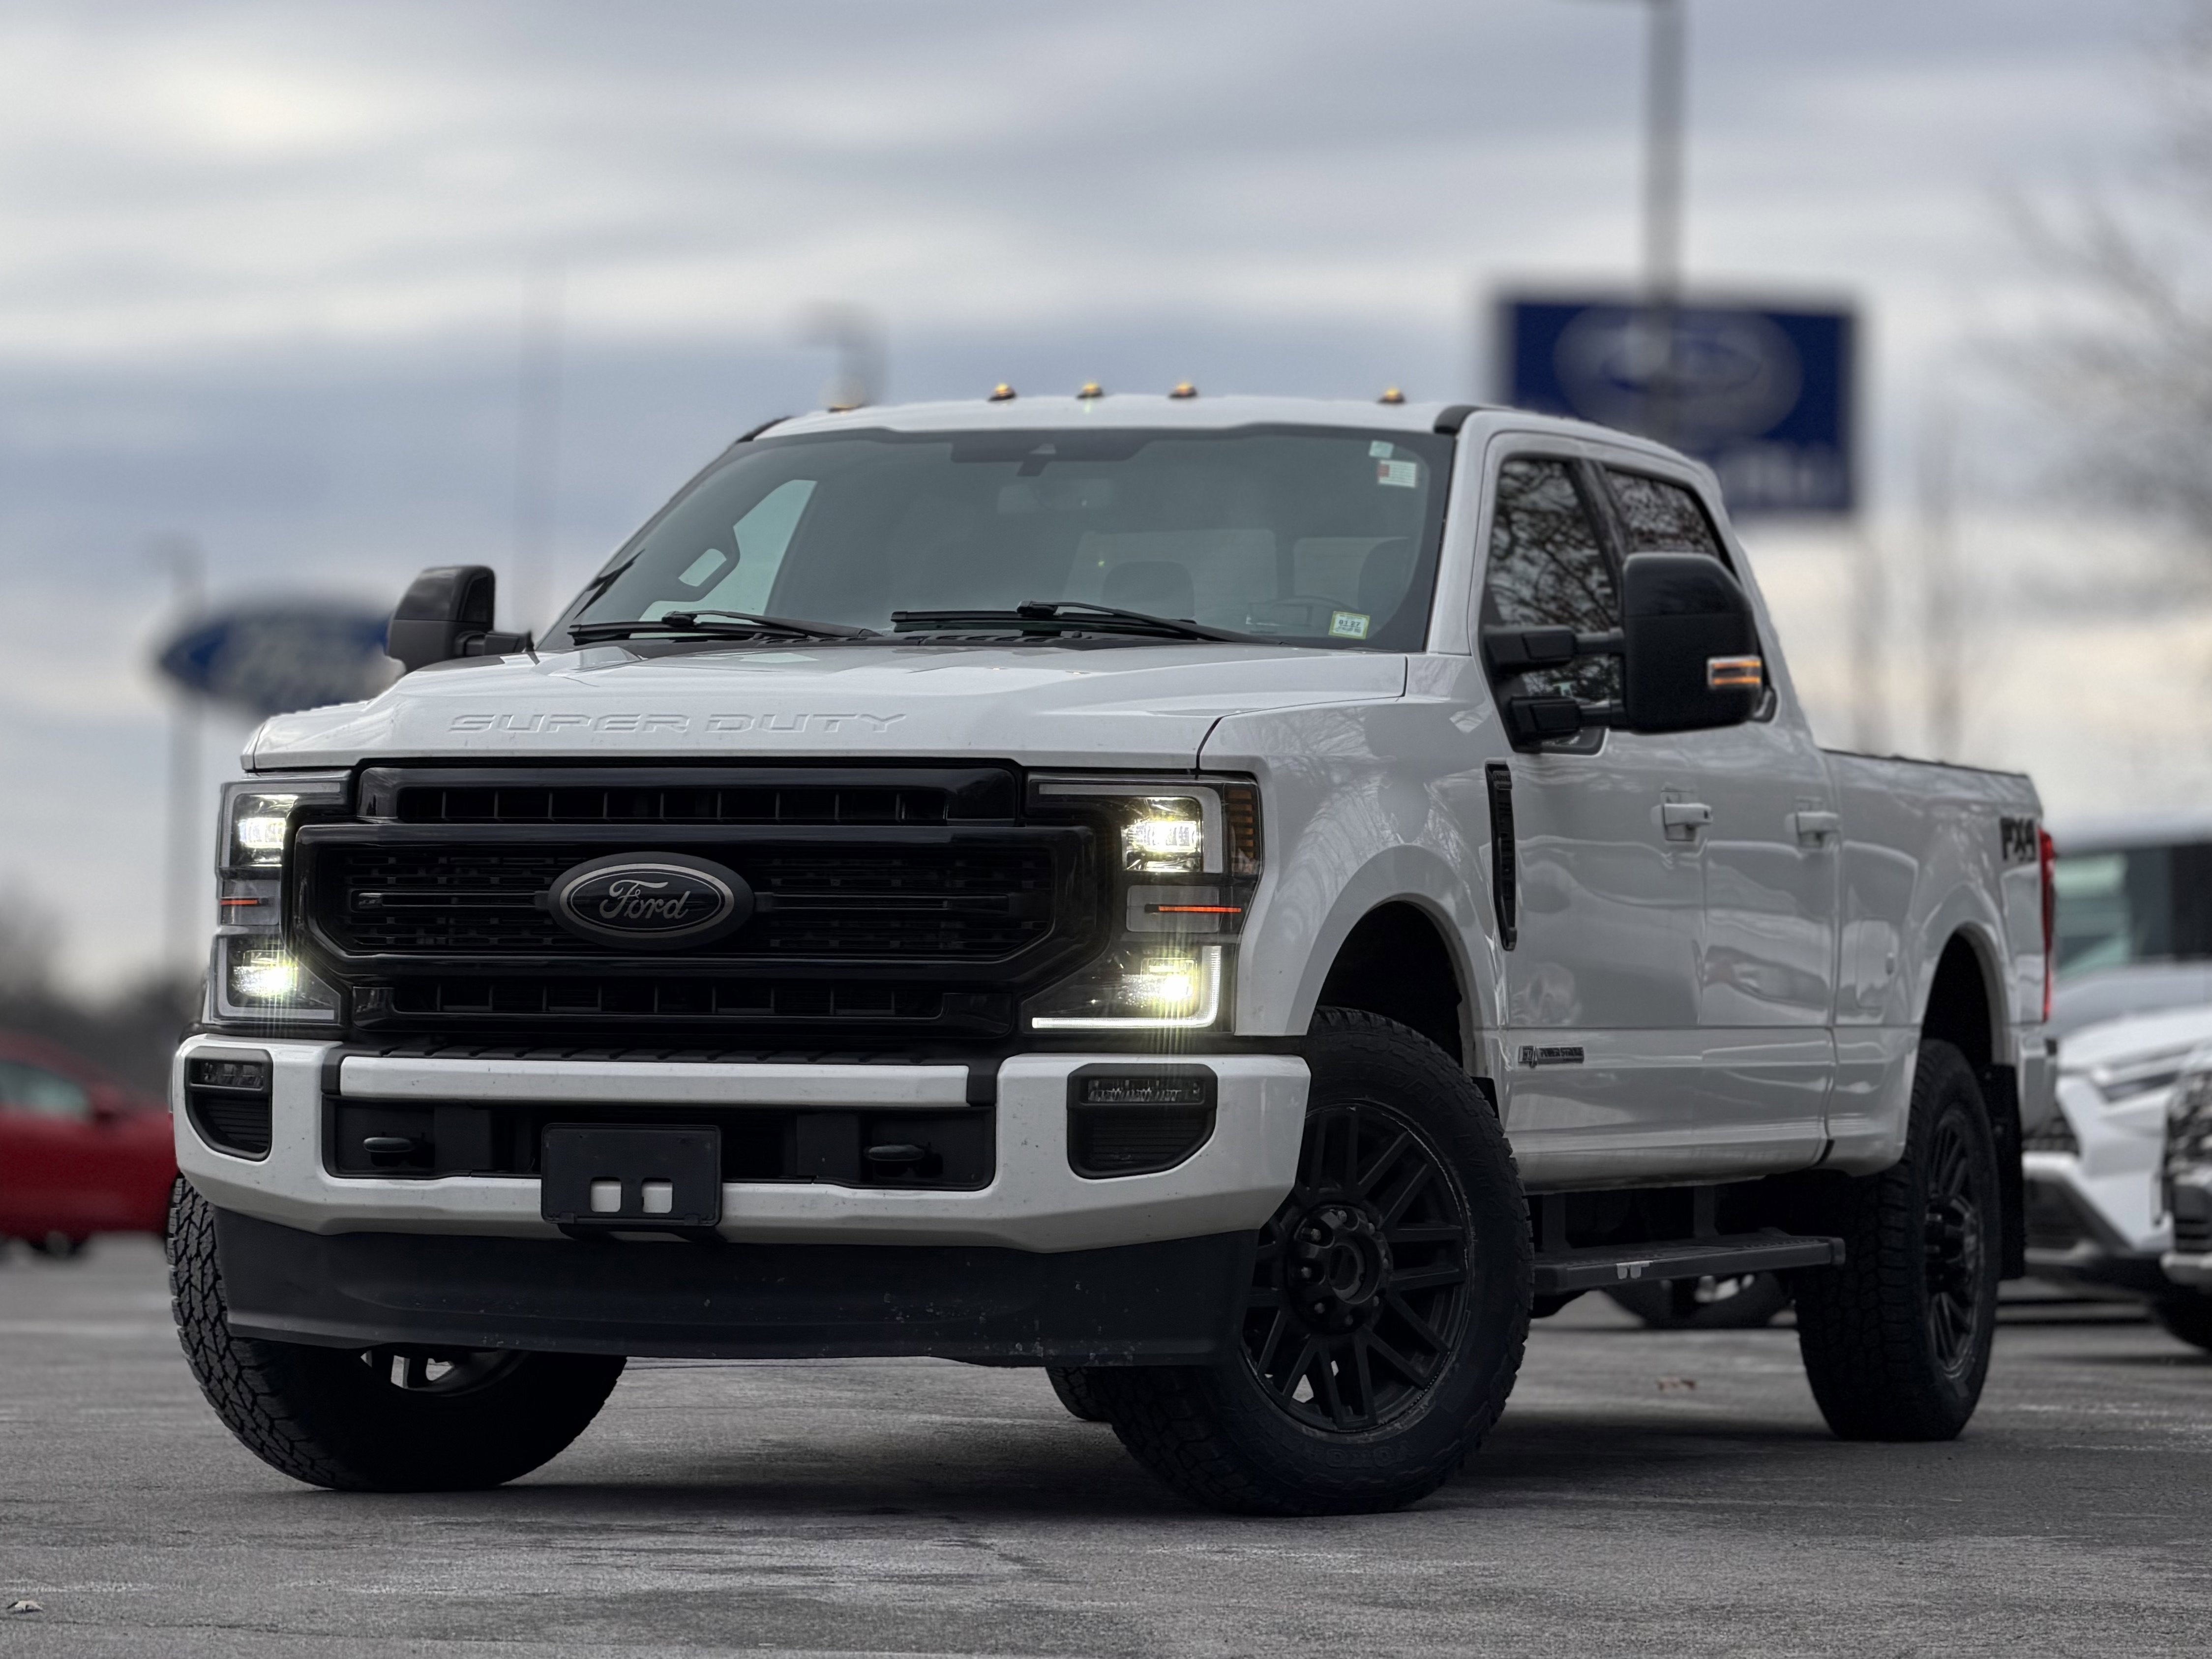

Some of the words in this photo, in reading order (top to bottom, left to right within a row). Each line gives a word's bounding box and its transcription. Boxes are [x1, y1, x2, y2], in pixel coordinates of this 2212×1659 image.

[448, 714, 690, 733] SUPER
[705, 714, 907, 733] DUTY
[599, 879, 691, 919] Ford
